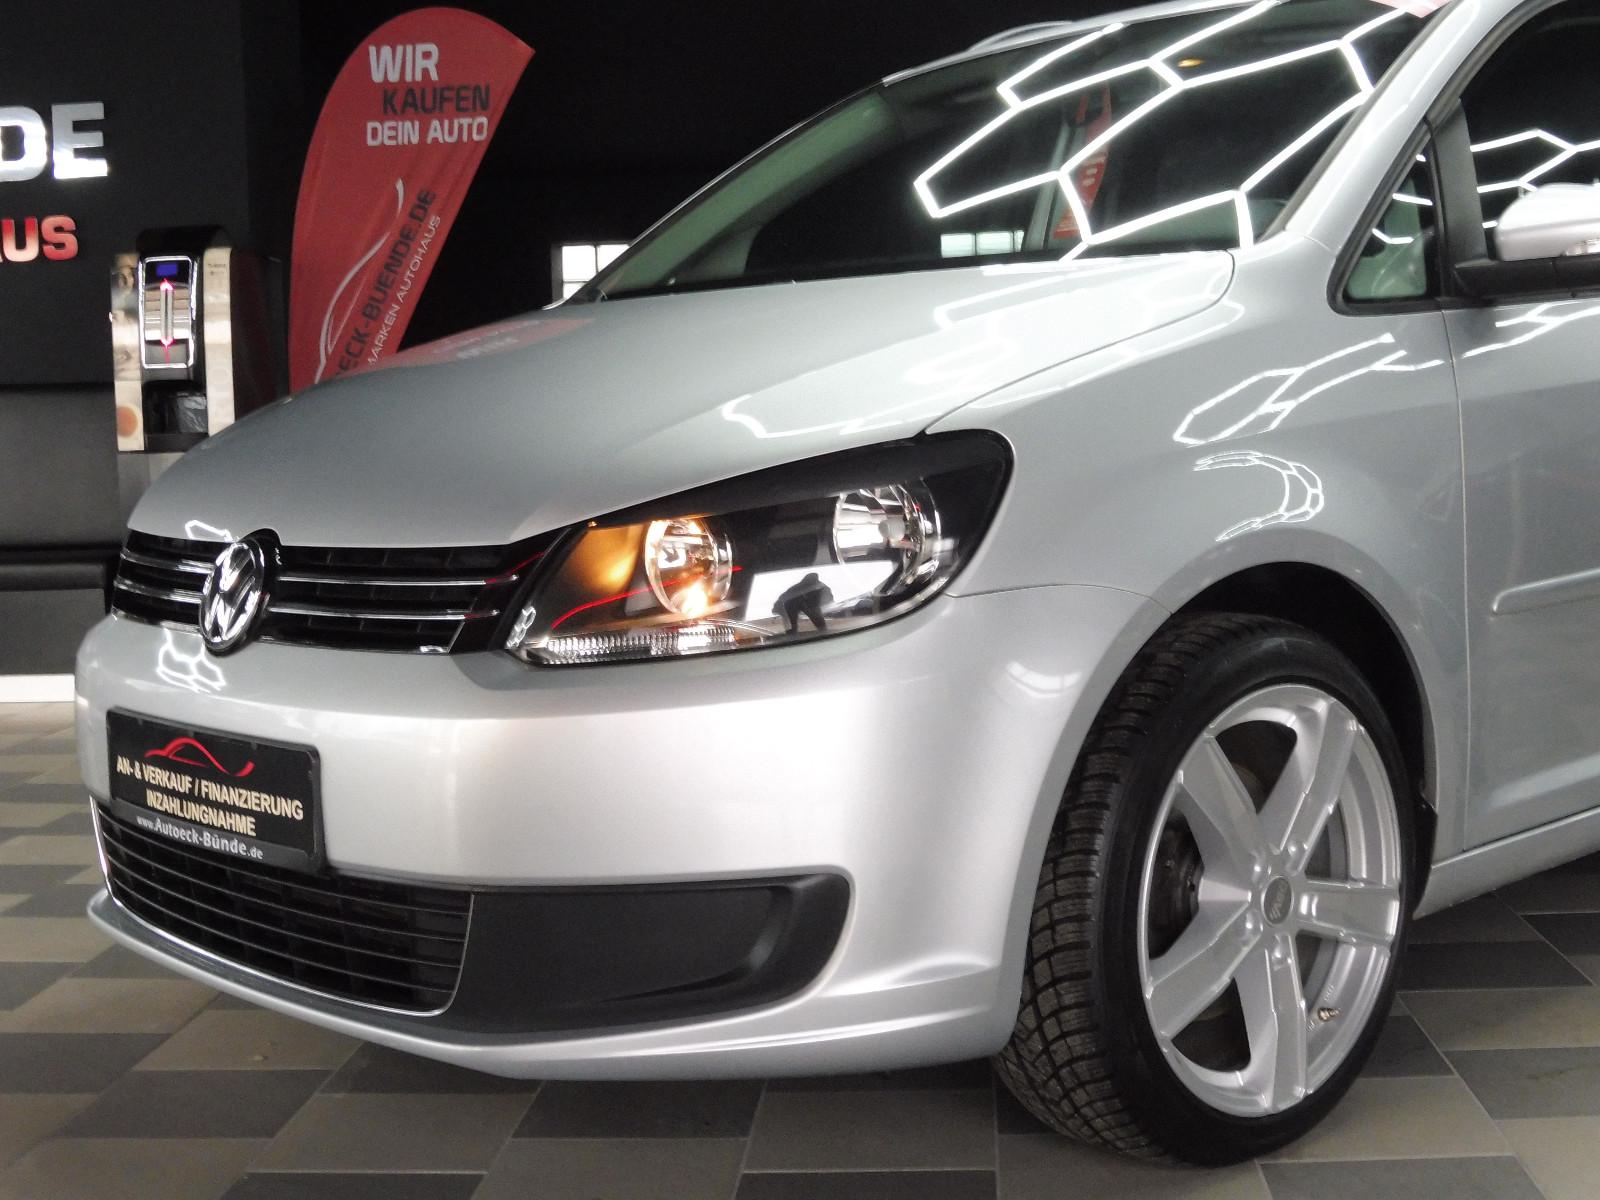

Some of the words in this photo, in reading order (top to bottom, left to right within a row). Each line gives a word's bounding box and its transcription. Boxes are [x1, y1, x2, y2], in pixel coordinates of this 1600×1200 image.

[368, 43, 439, 83] WIR
[382, 83, 490, 115] KAUFEN
[366, 120, 420, 147] DEIN
[426, 115, 489, 144] AUTO
[0, 214, 79, 263] US
[396, 214, 441, 304] AUTOHAUS
[336, 187, 437, 376] ECK-BUENDE.DE
[116, 755, 134, 776] AN-
[134, 764, 142, 780] &
[142, 765, 193, 795] VERKAUF
[201, 781, 304, 821] FINANZIERUNG
[146, 788, 257, 837] INZAHLUNGNAHME
